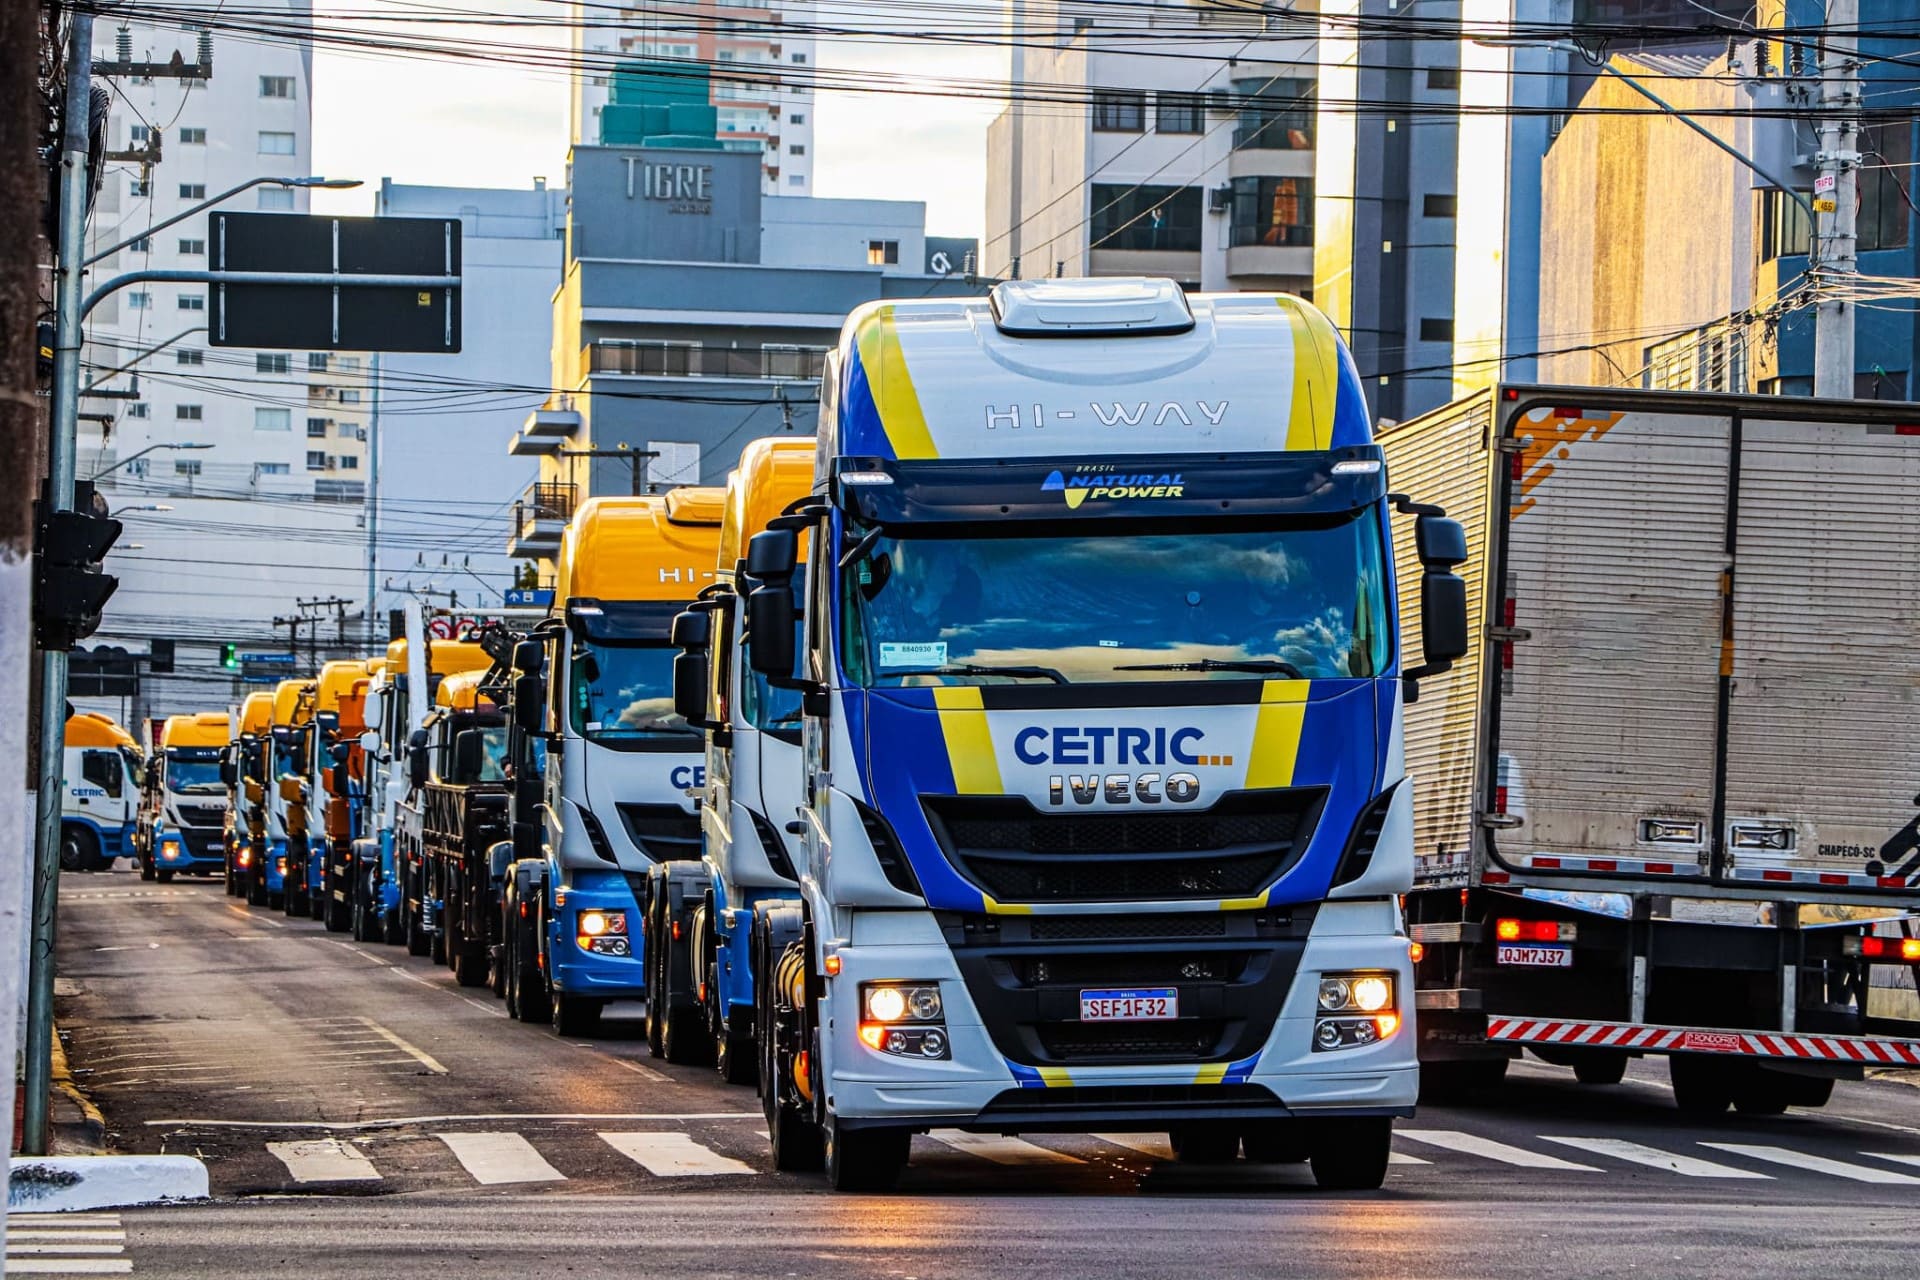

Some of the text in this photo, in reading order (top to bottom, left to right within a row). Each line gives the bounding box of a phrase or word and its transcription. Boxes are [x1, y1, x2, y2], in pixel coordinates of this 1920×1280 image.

[621, 156, 712, 200] TIGRE
[985, 401, 1229, 429] HI-WAY
[1076, 465, 1116, 473] BRASIL
[1068, 474, 1185, 487] NATURAL
[1090, 486, 1184, 499] POWER
[71, 788, 104, 797] CETRIC
[1049, 772, 1200, 805] IVECO
[1818, 844, 1876, 858] CHAPECÓ-SC
[1504, 948, 1564, 964] QJM7J37
[1089, 999, 1167, 1017] SEF1F32
